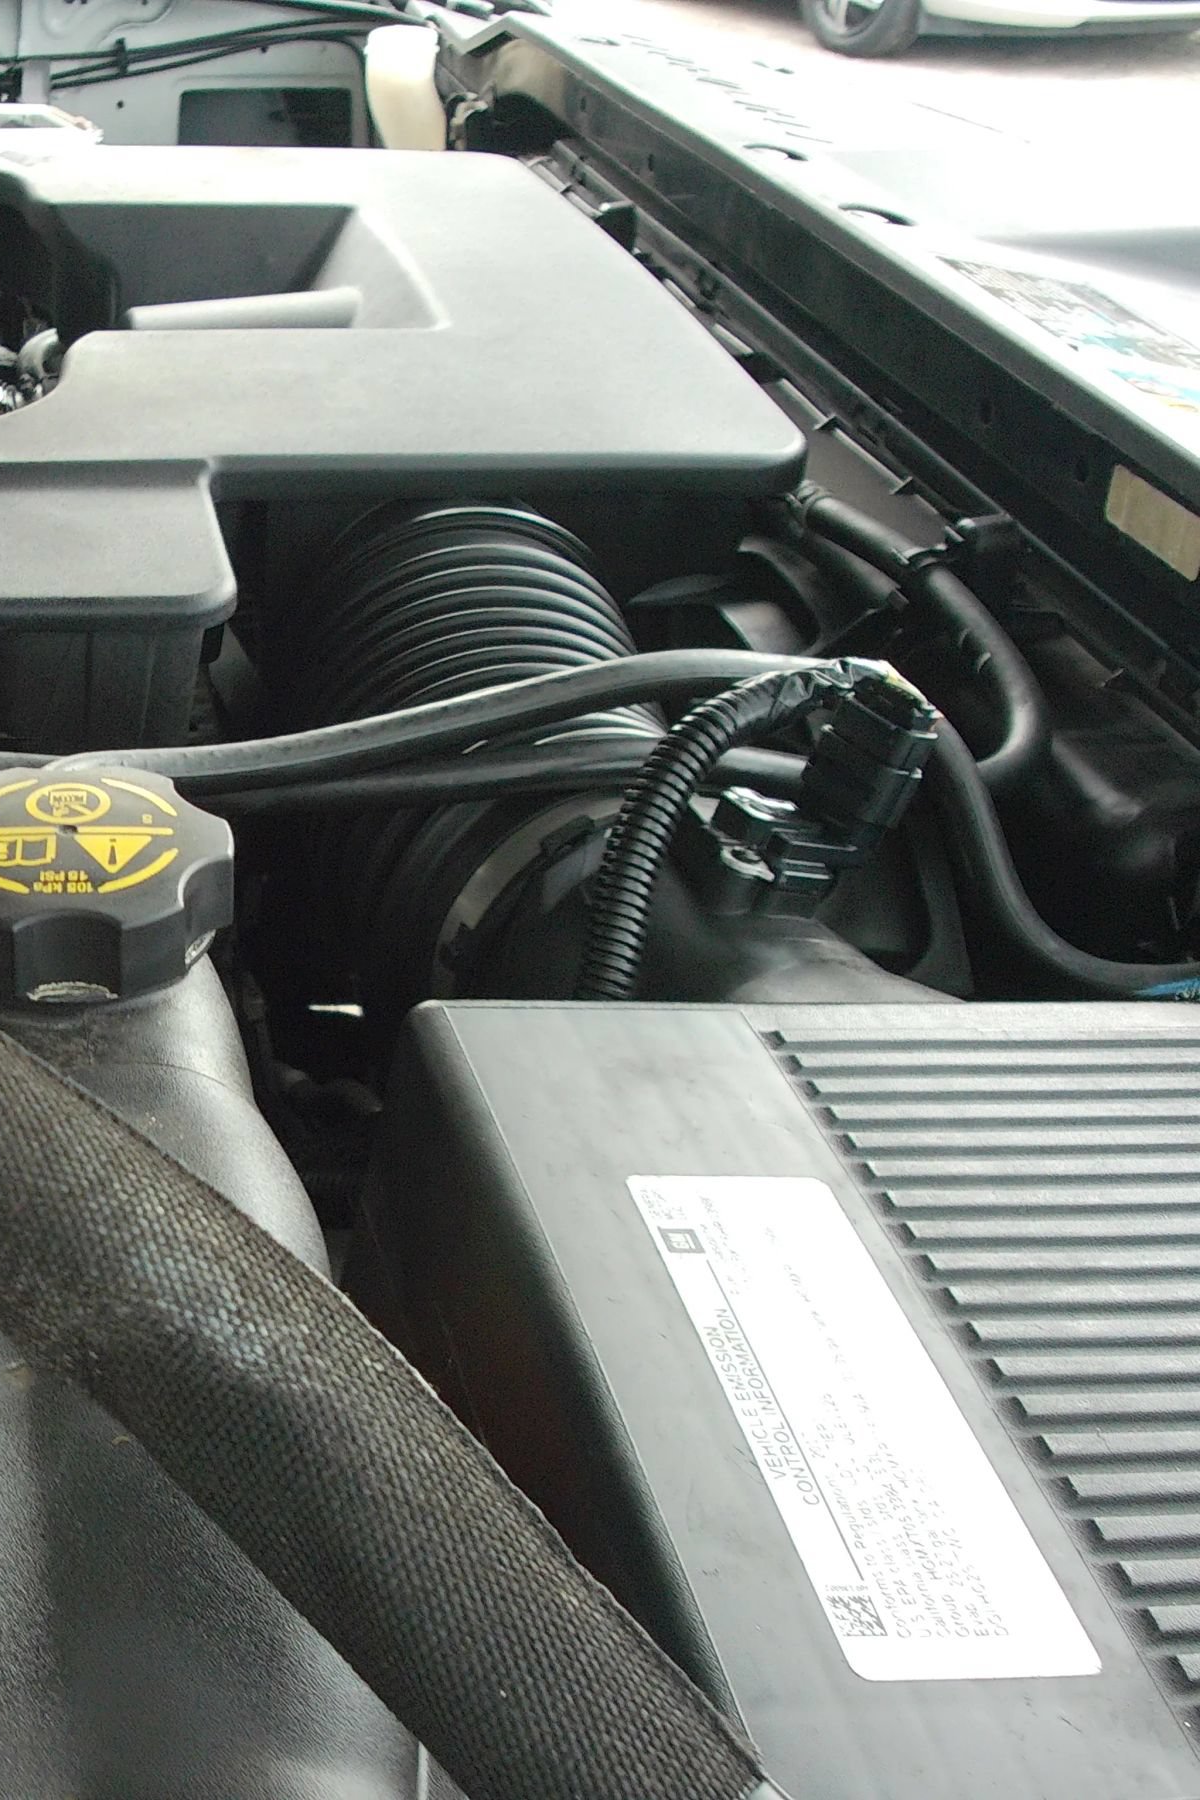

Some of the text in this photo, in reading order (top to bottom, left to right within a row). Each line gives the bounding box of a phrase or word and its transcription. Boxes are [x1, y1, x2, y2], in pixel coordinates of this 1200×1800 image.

[701, 1325, 752, 1401] EMISSION
[710, 1307, 779, 1415] INFORMATION
[739, 1407, 789, 1480] VEHICLE
[764, 1420, 824, 1505] CONTROL
[866, 1570, 915, 1639] Conforms
